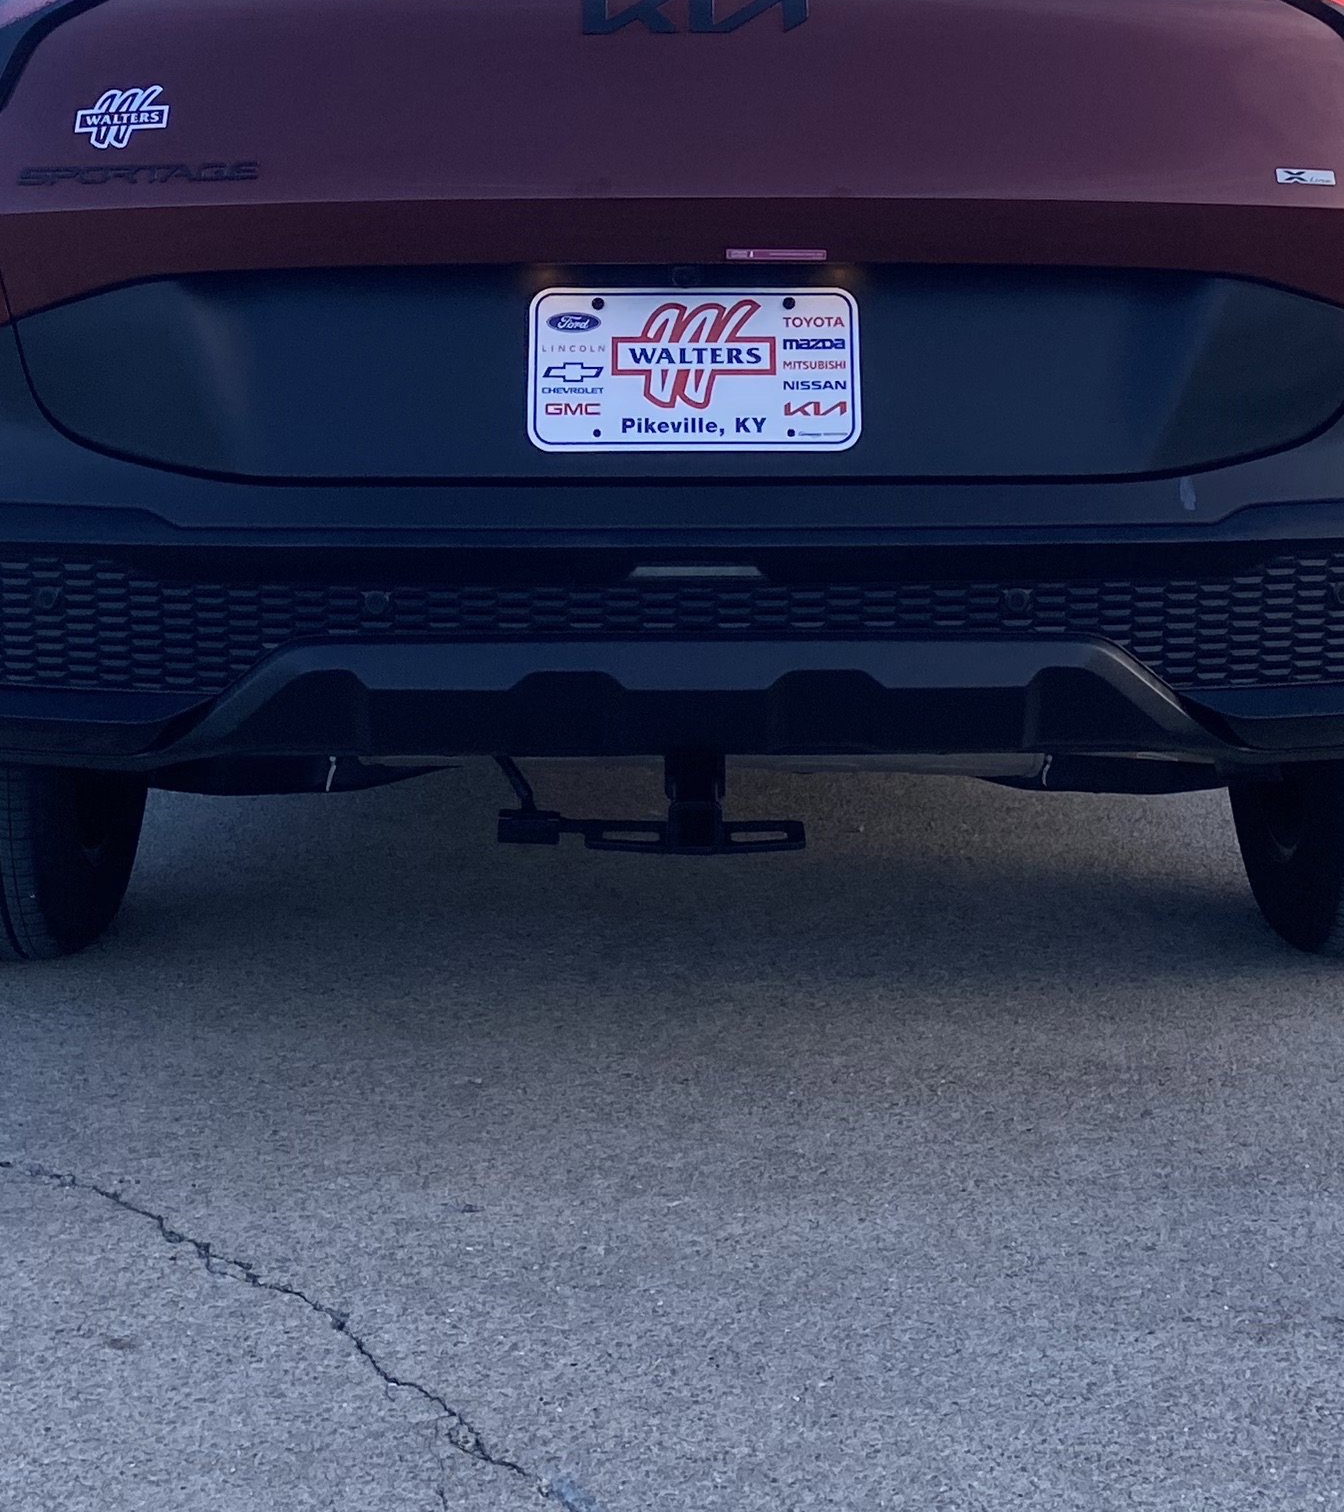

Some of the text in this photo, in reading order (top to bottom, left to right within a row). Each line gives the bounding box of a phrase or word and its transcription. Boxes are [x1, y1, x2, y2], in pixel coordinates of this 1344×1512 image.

[85, 111, 161, 127] WALTERS
[16, 161, 261, 186] SPORTAGE
[557, 315, 590, 329] Ford
[782, 316, 845, 328] TOYOTA
[542, 345, 606, 353] LINCOLN
[629, 347, 763, 365] WALTERS
[782, 361, 846, 370] MITSUBISHI
[783, 380, 847, 390] NISSAN
[545, 403, 601, 415] GMC
[784, 401, 847, 416] KIA
[621, 417, 767, 436] Pikeville, KY
